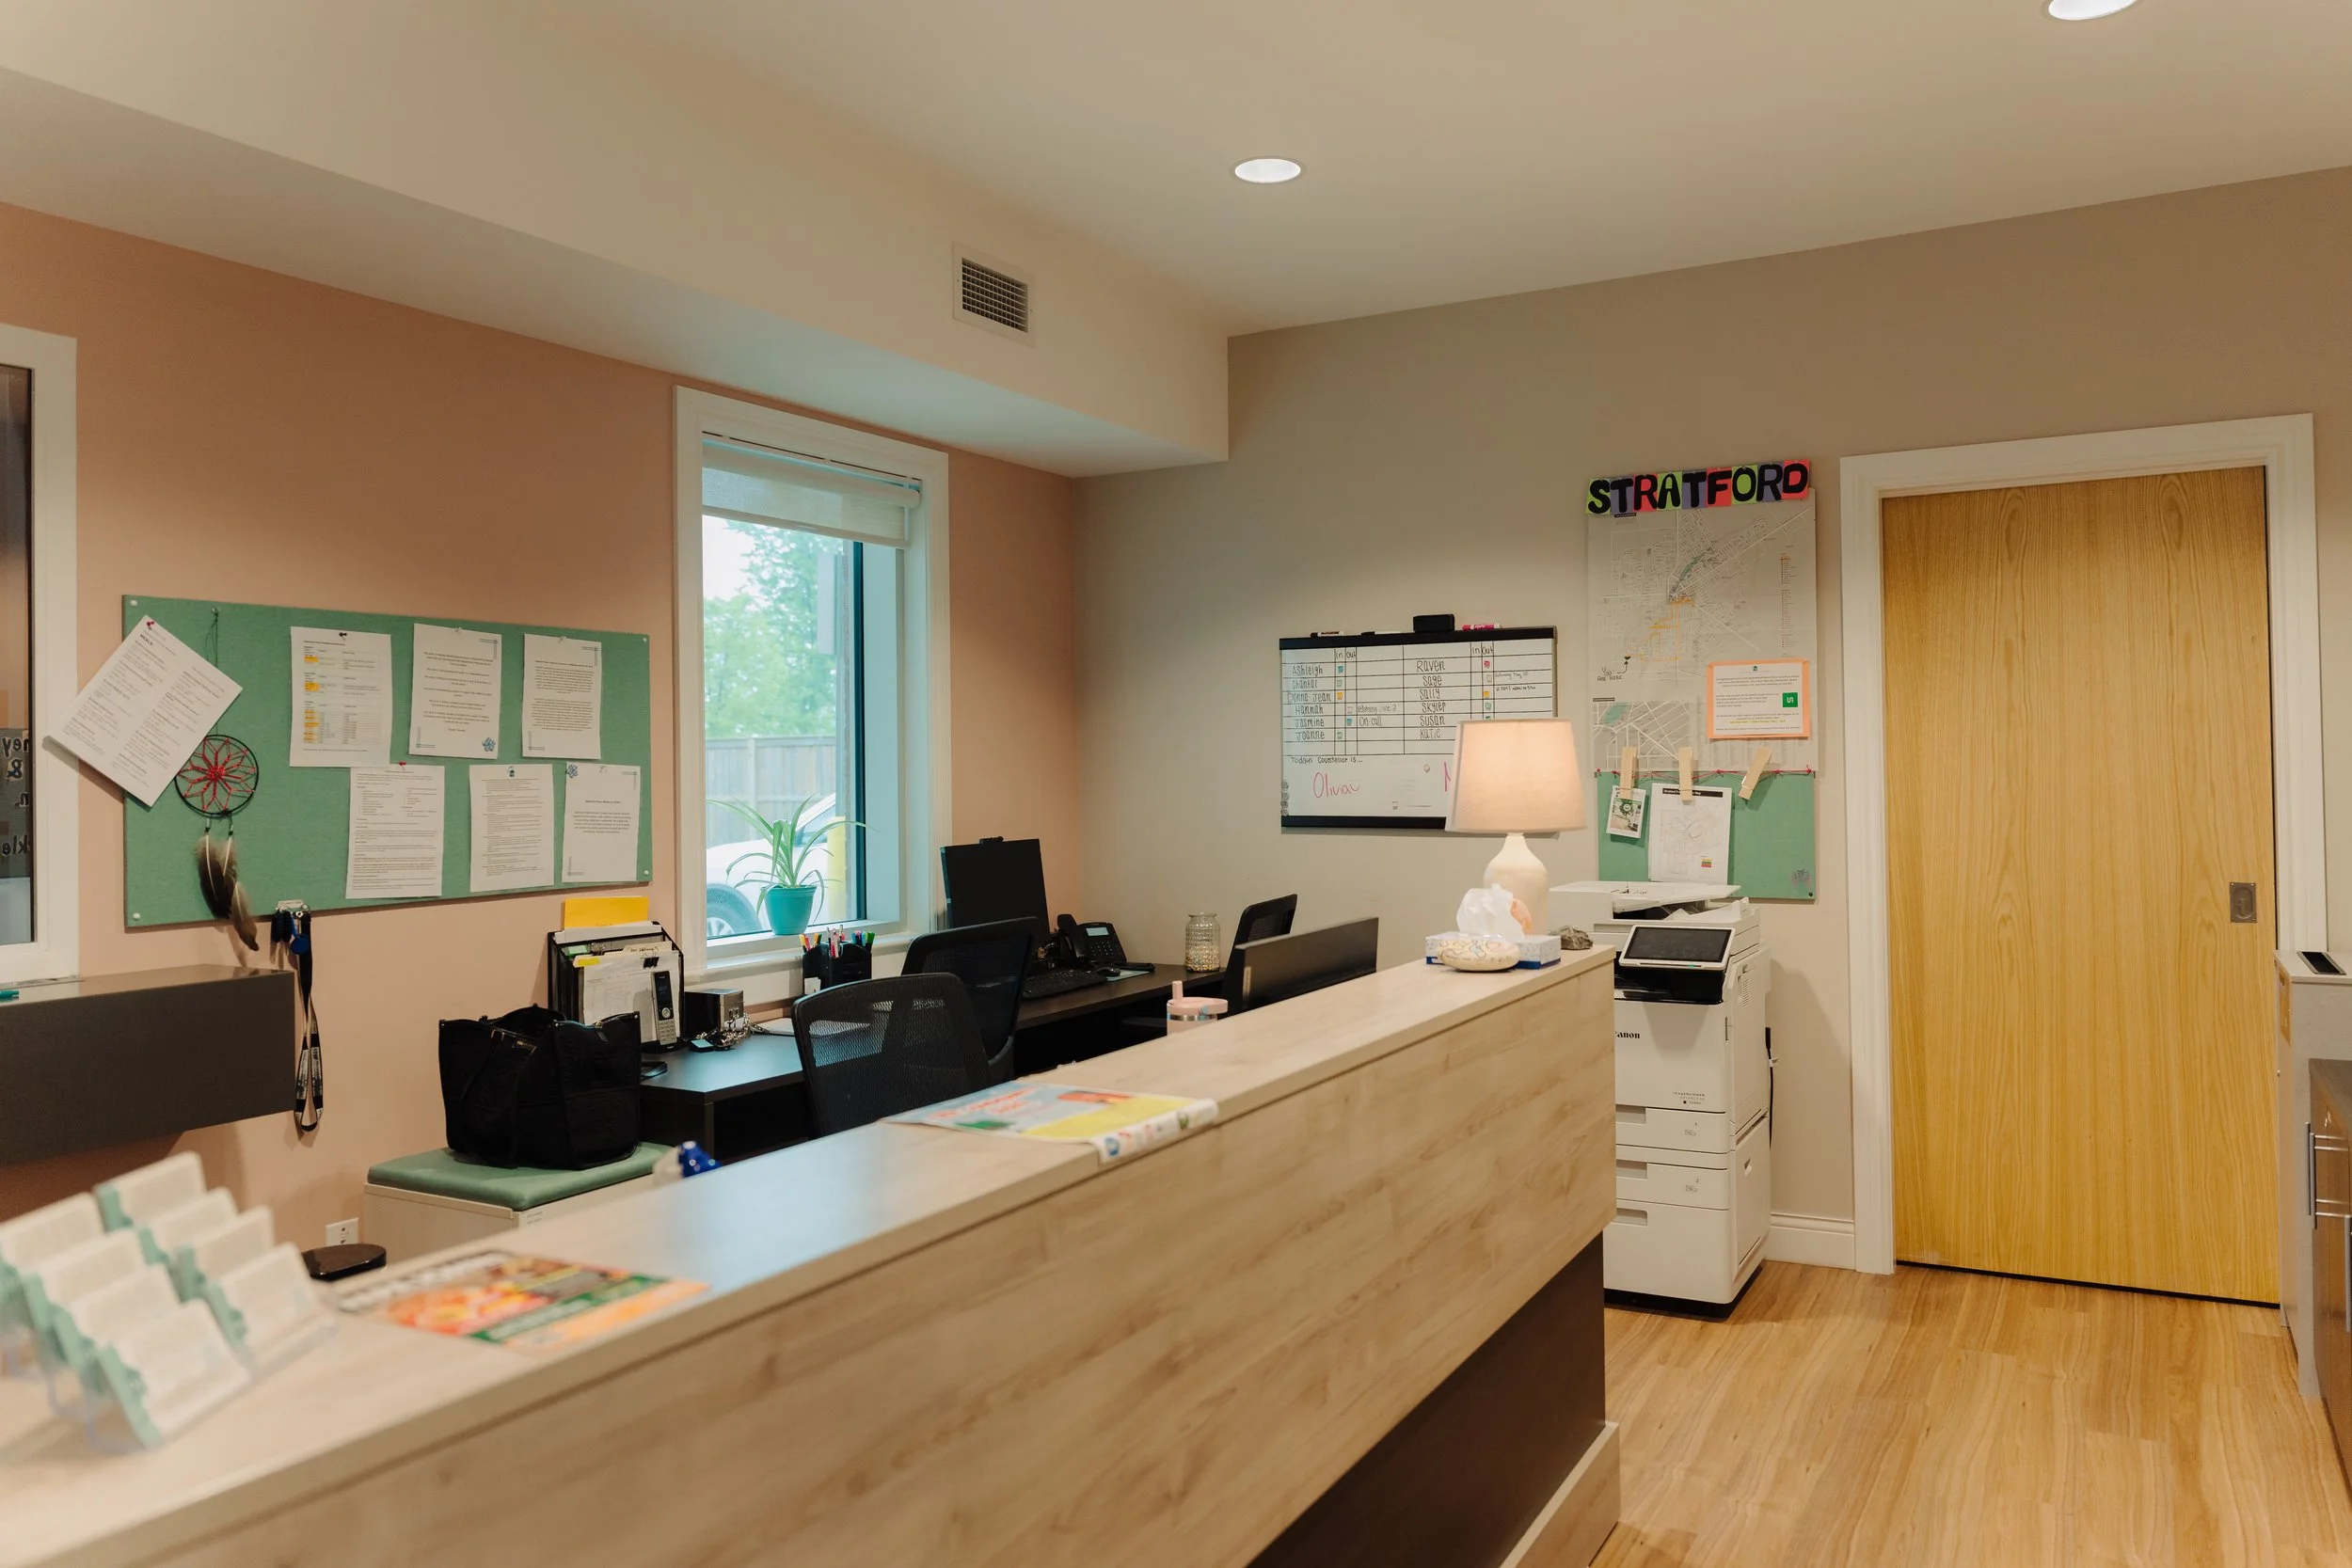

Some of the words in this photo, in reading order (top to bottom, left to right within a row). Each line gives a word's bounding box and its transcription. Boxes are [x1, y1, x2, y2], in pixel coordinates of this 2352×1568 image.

[1588, 463, 1808, 515] STRATFORD
[1416, 660, 1446, 673] Raven
[1422, 675, 1442, 688] Sage
[1295, 705, 1325, 715] Hannah
[1420, 715, 1446, 727] Susan
[1295, 730, 1326, 741] Joanne
[1312, 771, 1360, 799] Olivia
